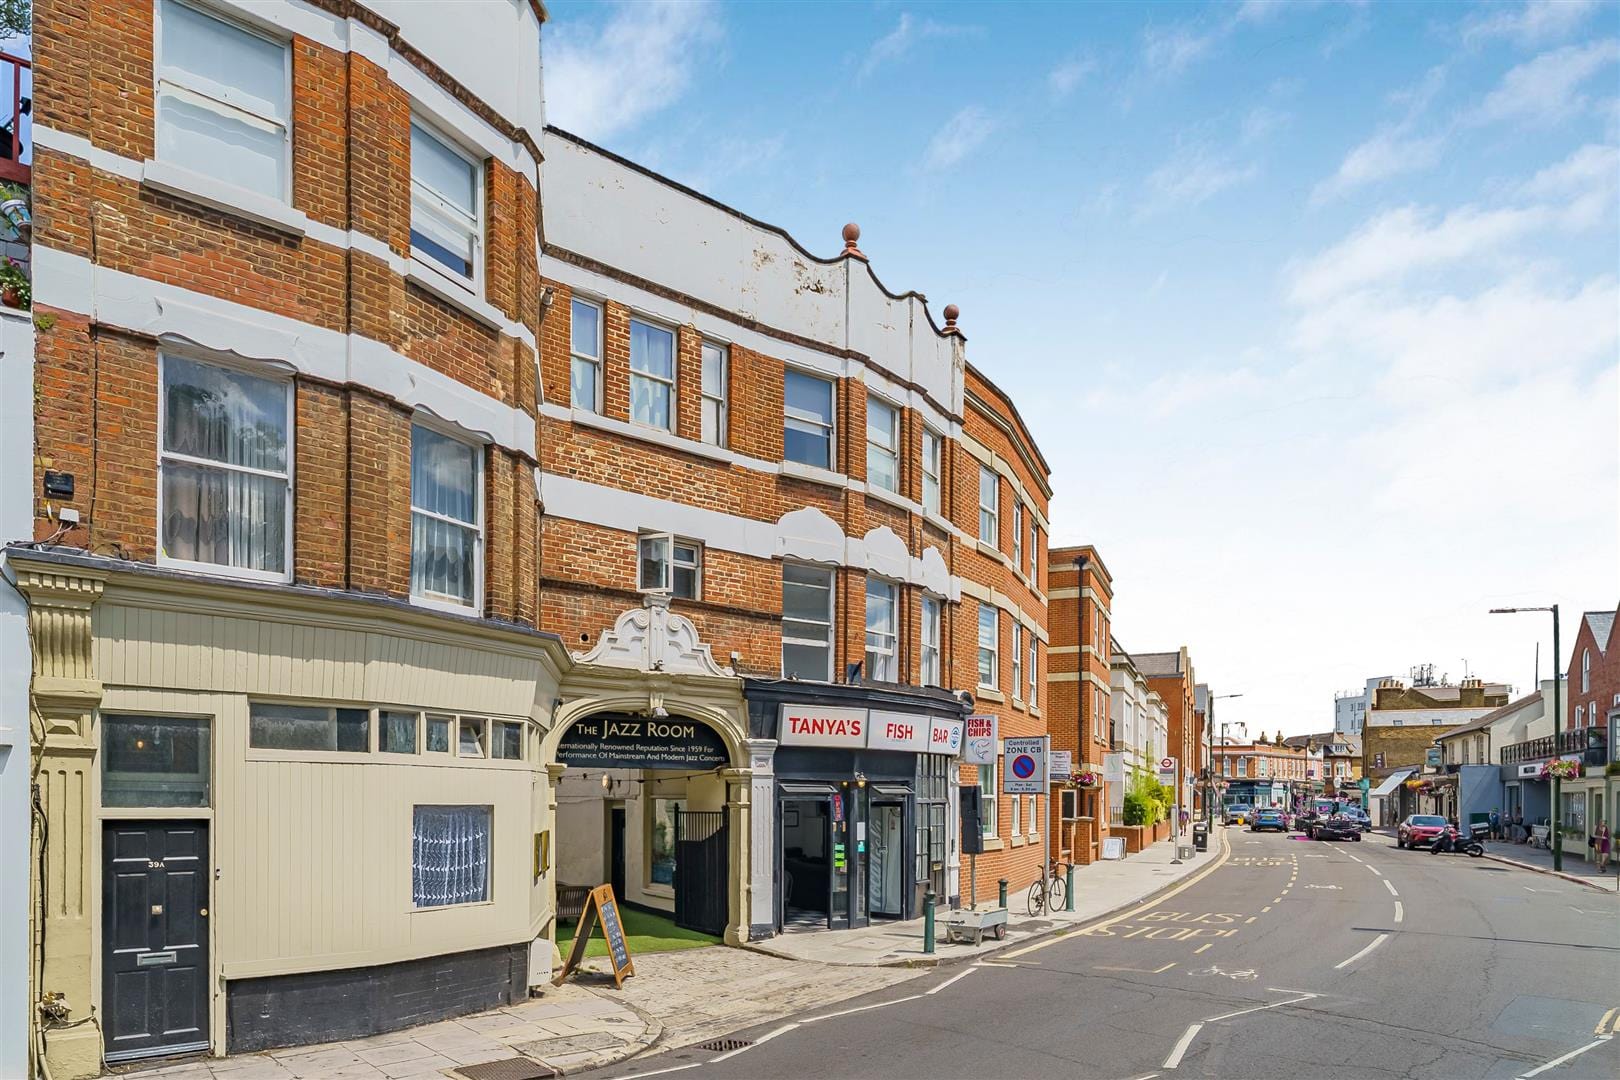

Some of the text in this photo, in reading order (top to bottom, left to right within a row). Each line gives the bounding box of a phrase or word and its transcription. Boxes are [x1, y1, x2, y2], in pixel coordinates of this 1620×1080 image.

[967, 719, 985, 728] FISH
[576, 720, 695, 739] THE JAZZ ROOM
[789, 717, 861, 737] TANYA'S
[886, 723, 913, 740] FISH
[932, 727, 948, 743] BAR
[967, 727, 992, 737] CHIPS
[600, 743, 634, 751] Renowned
[635, 744, 669, 753] Reputation
[687, 745, 702, 753] 1959
[608, 752, 646, 760] Mainstream
[686, 754, 698, 762] Jazz
[1137, 911, 1243, 924] BUS
[1086, 925, 1228, 941] STOP
